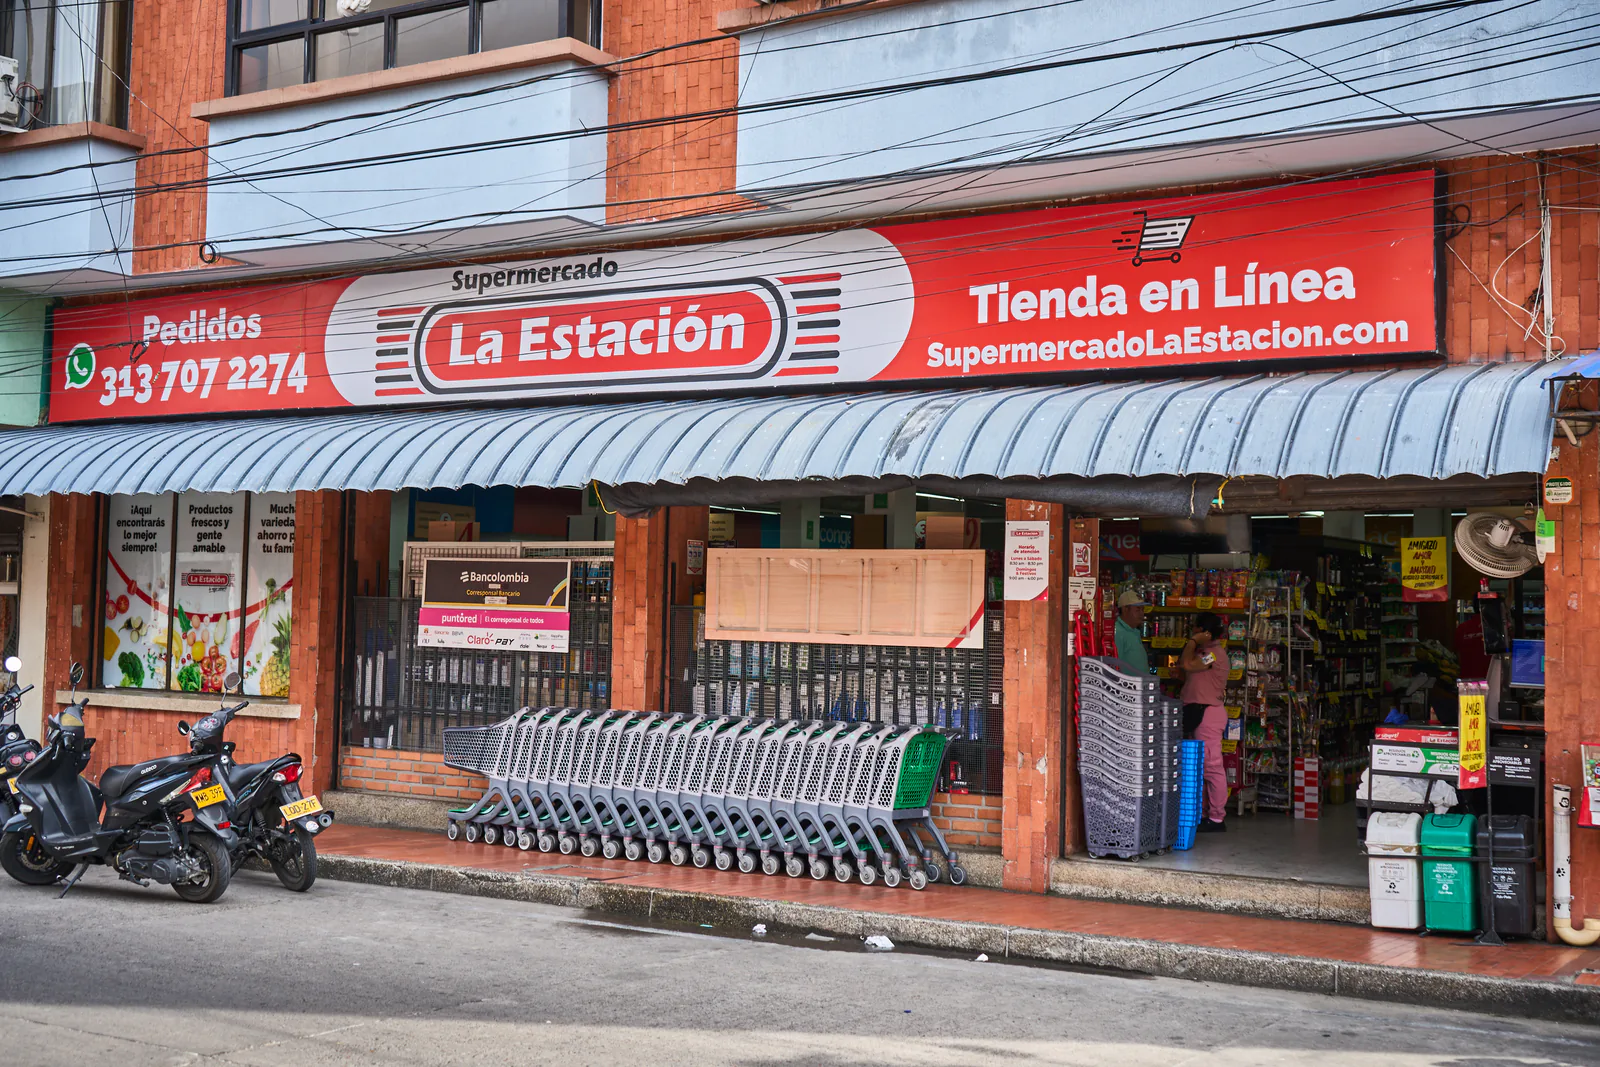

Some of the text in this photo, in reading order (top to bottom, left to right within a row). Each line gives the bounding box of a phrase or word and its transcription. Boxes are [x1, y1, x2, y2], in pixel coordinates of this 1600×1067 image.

[451, 257, 618, 294] Supermercado
[969, 261, 1356, 324] Tienda en Línea
[143, 308, 262, 346] Pedidos
[448, 304, 745, 367] La Estación
[927, 318, 1409, 373] SupermercadoLaEstacion.com
[99, 352, 308, 406] 313 707 2274
[130, 504, 152, 517] ¡Aquí
[188, 504, 233, 514] Productos
[116, 518, 166, 528] encontrarás
[191, 517, 230, 530] frescos y
[124, 530, 157, 542] lo mejor
[196, 530, 222, 542] gente
[257, 530, 288, 540] ahorro
[122, 543, 157, 554] siempre!
[192, 543, 226, 552] amable
[262, 544, 272, 553] tu
[1408, 540, 1438, 550] AMIGAZO
[1412, 551, 1432, 560] AMOR
[1409, 565, 1436, 574] AMISTAD
[200, 575, 226, 583] Estación
[470, 572, 530, 583] Bancolombia
[490, 616, 522, 624] corresponsal
[466, 633, 490, 645] Claro
